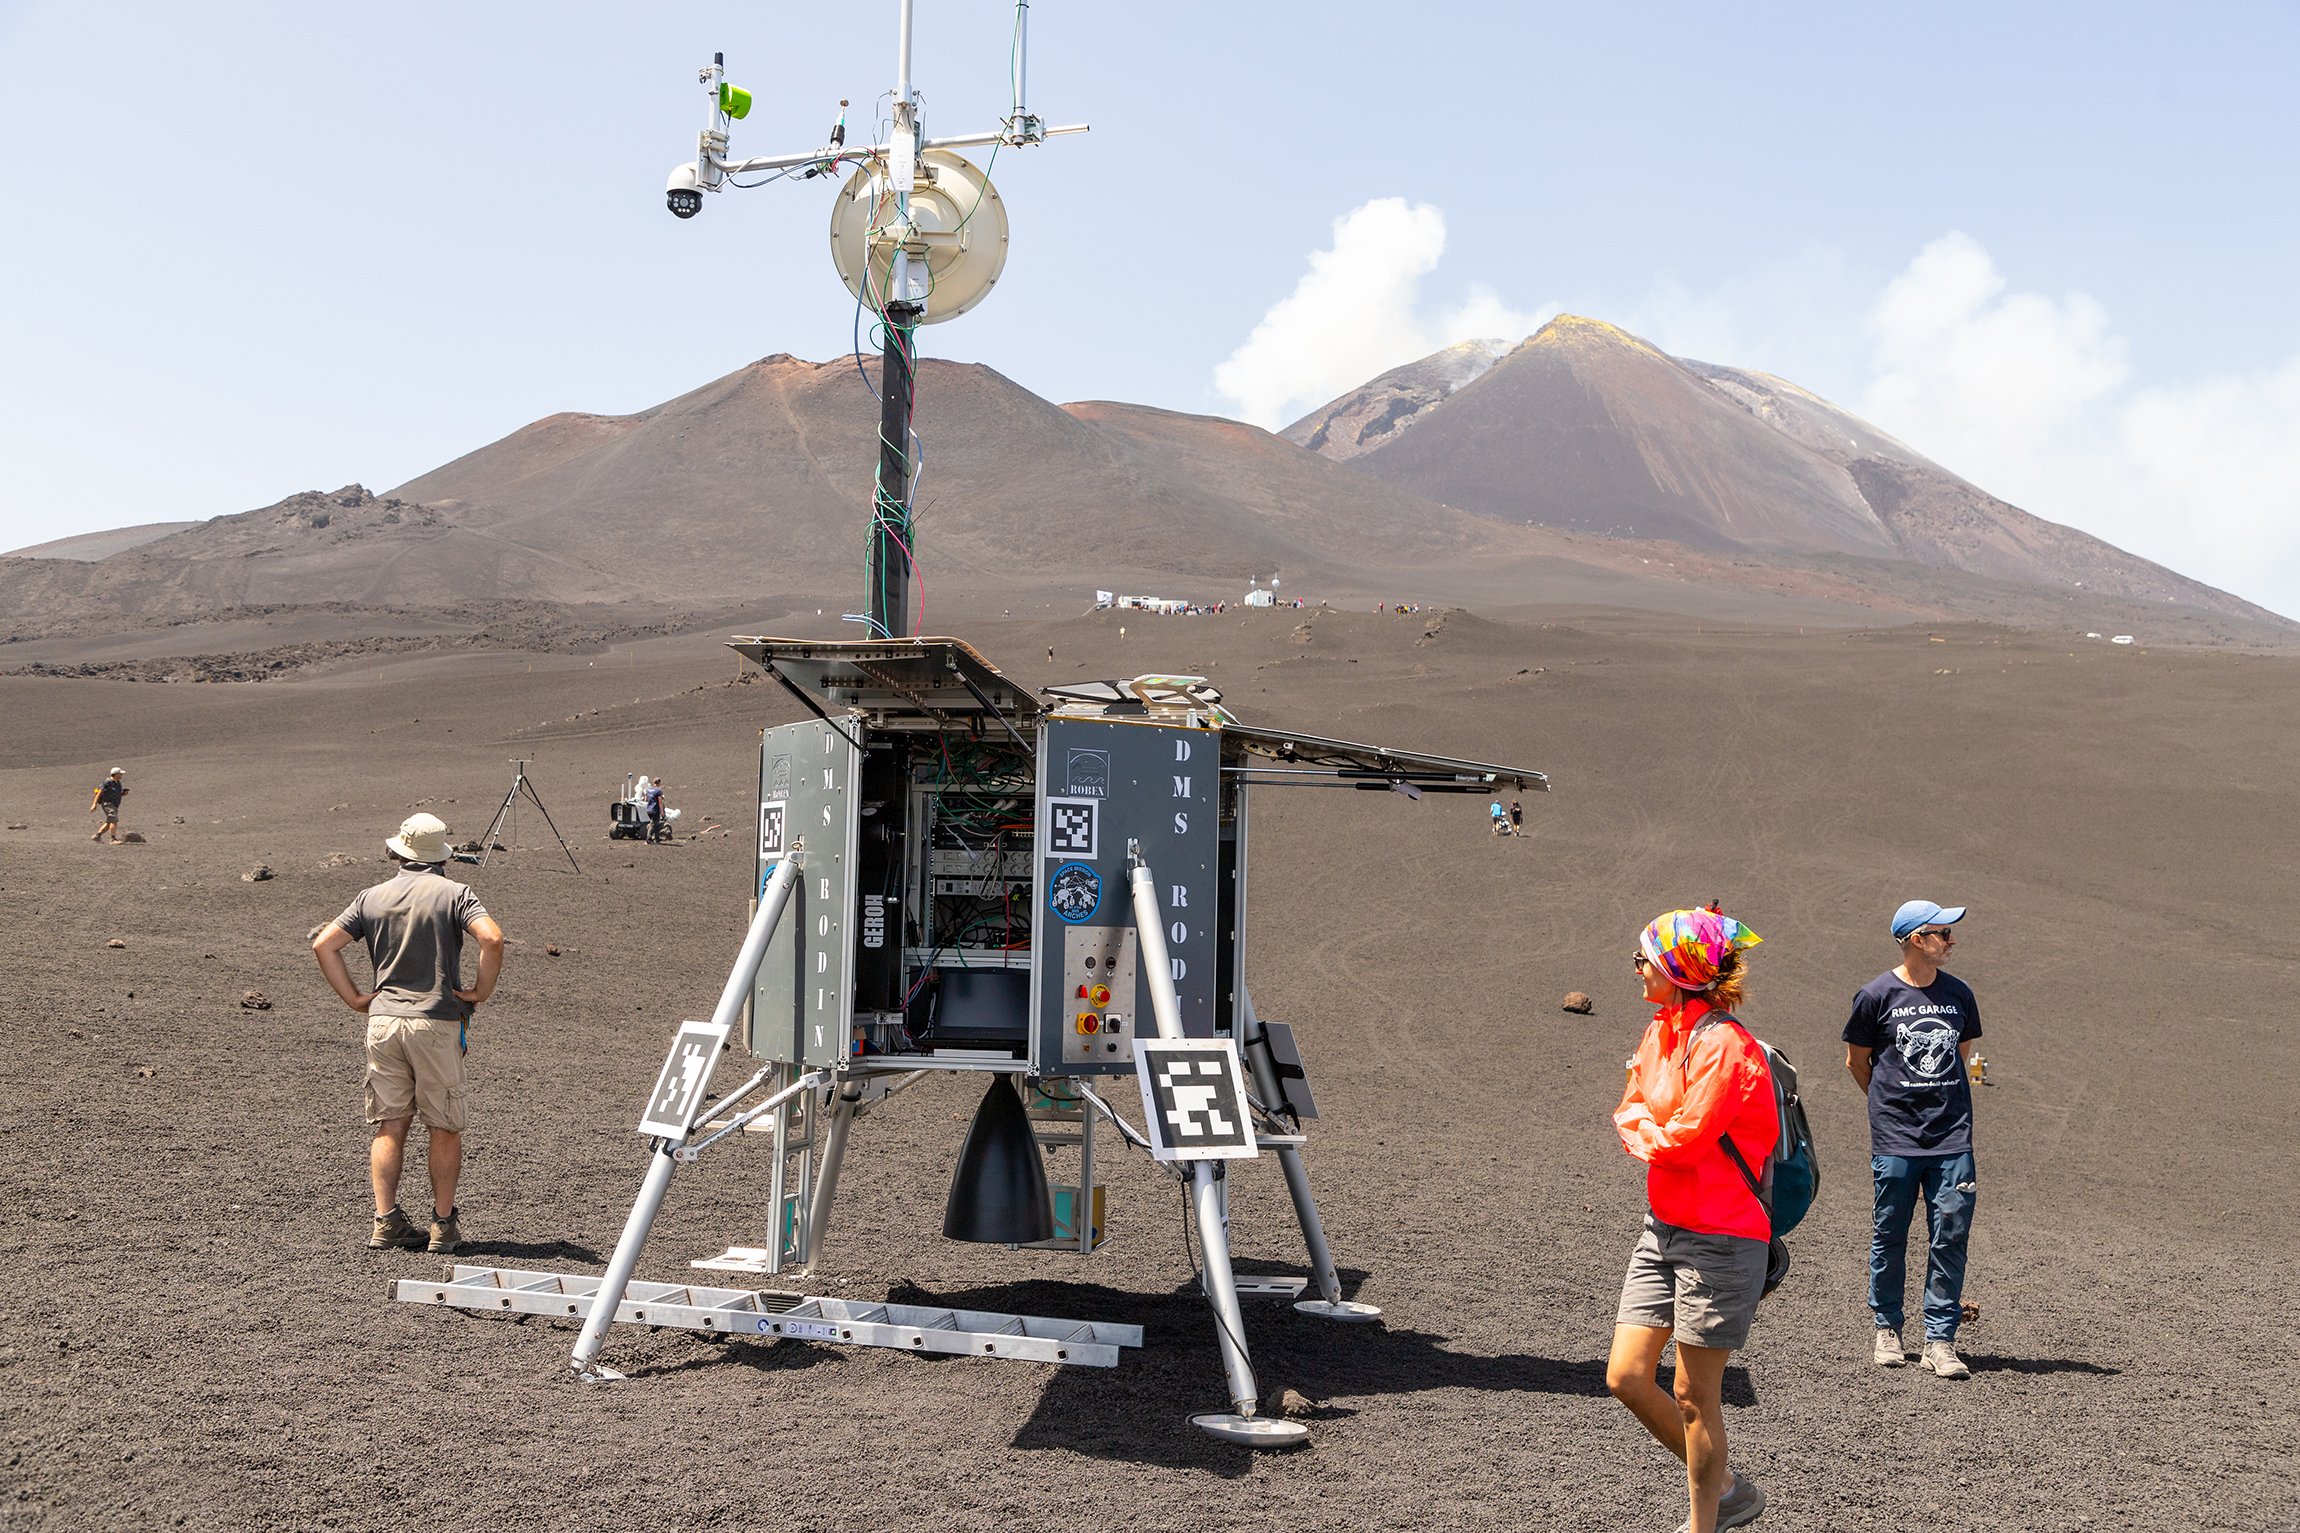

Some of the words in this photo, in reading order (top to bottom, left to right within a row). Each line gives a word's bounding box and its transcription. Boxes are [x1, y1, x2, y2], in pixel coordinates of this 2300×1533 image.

[822, 732, 834, 826] DMS
[1070, 784, 1105, 797] ROBEX
[1172, 739, 1192, 835] DMS
[864, 894, 885, 948] GEROH
[1063, 910, 1088, 919] ARCHES
[814, 878, 830, 1047] RODIN
[1892, 1006, 1917, 1018] RMC
[1918, 1005, 1958, 1015] GARAGE
